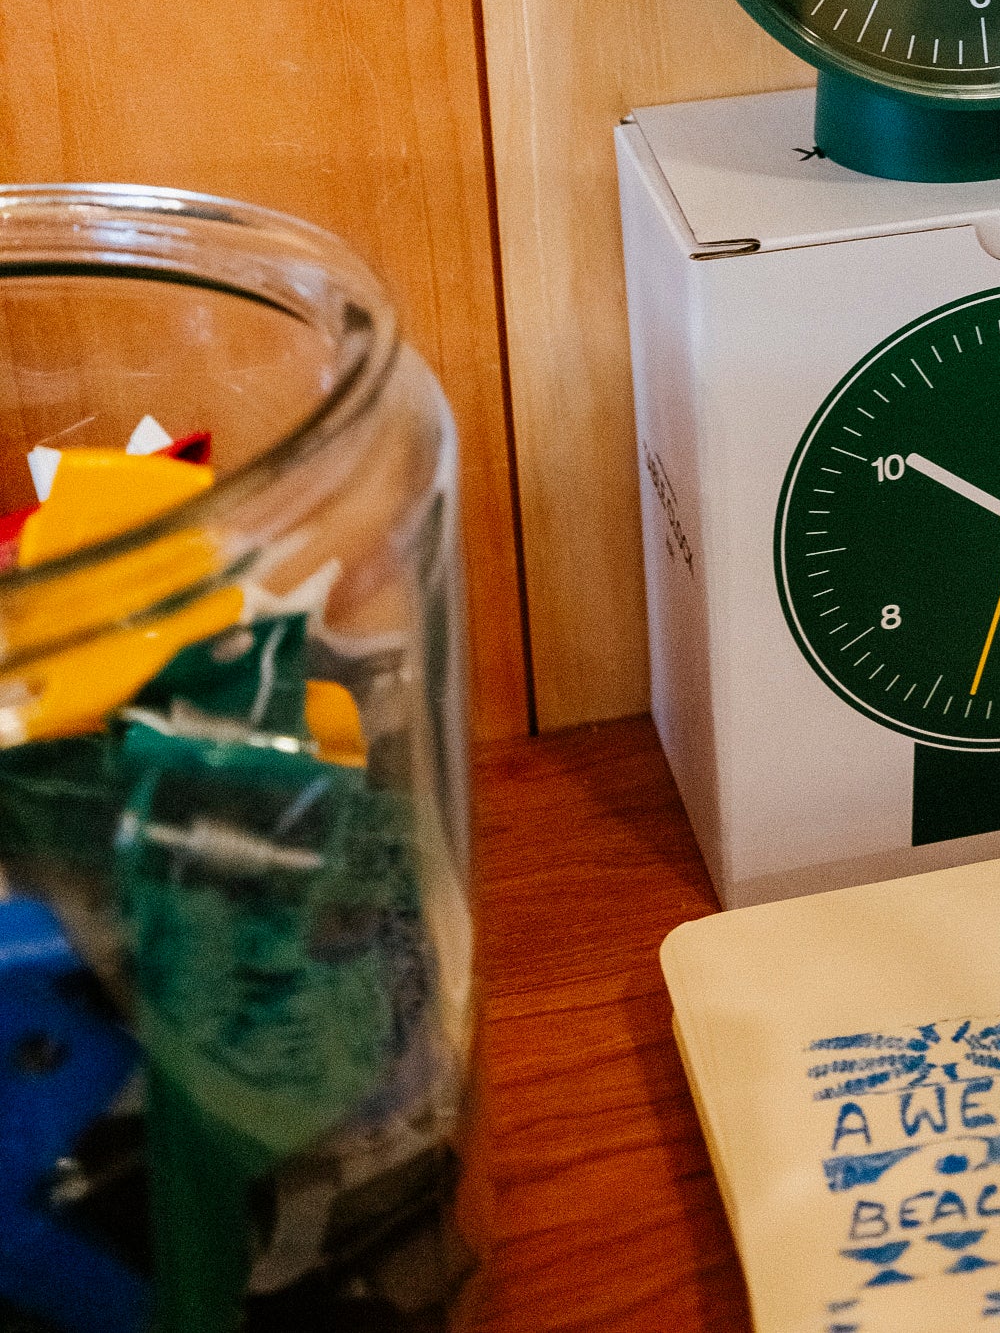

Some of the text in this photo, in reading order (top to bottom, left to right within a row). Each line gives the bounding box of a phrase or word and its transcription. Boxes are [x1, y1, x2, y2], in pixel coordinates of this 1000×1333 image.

[872, 455, 905, 482] 10
[880, 605, 901, 629] 8
[831, 1102, 872, 1151] A
